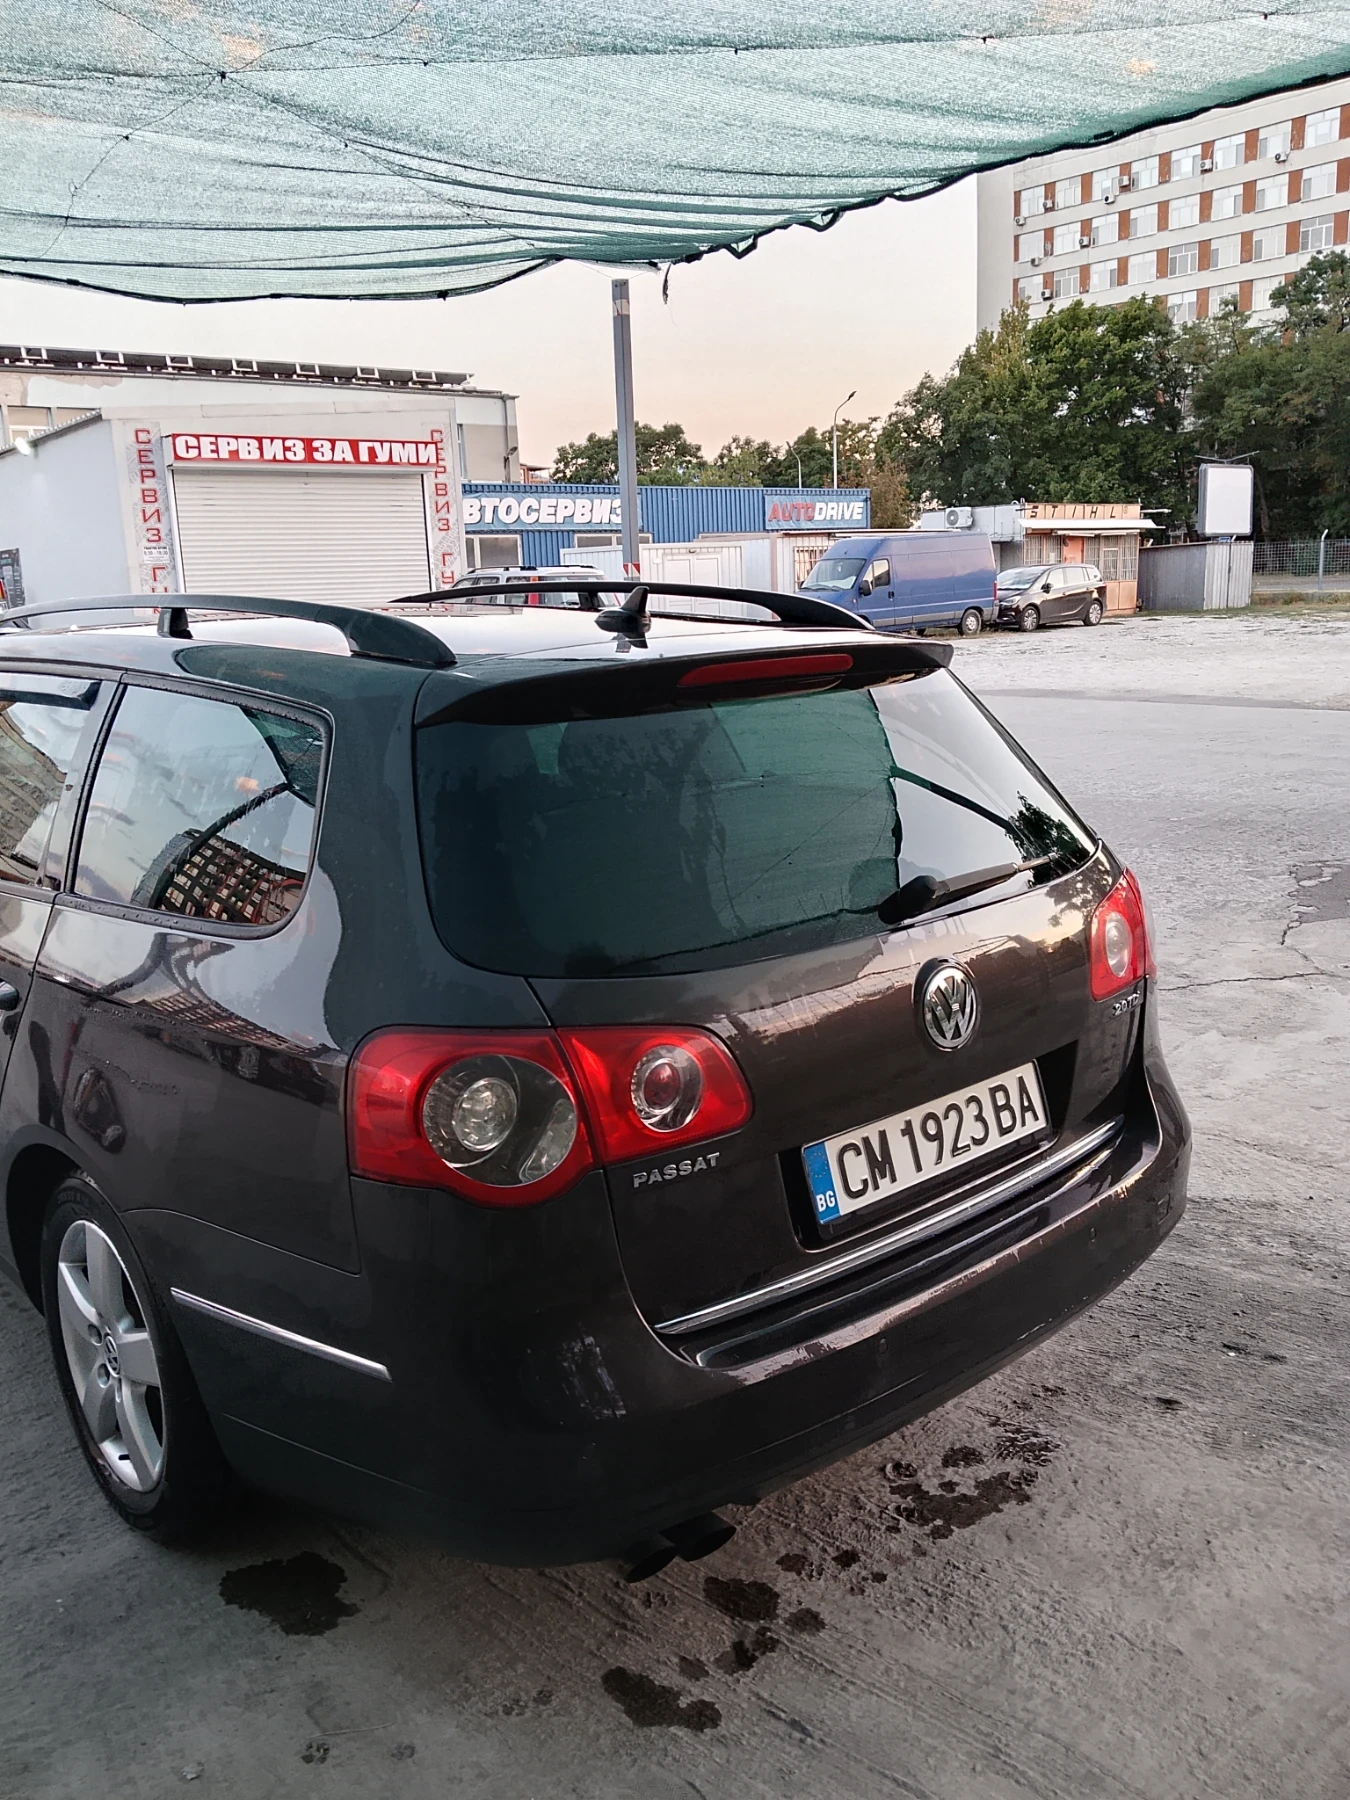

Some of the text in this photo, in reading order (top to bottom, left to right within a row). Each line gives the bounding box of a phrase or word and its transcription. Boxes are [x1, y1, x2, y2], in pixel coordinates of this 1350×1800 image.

[174, 435, 437, 464] СЕРВИЗ ЗА ГУМИ
[134, 428, 162, 543] СЕРВИЗ
[463, 497, 623, 525] ВТОСЕРВИЗ
[837, 1073, 1040, 1200] CM 1923 BA
[632, 1151, 721, 1189] PASSAT
[815, 1190, 836, 1213] BG
